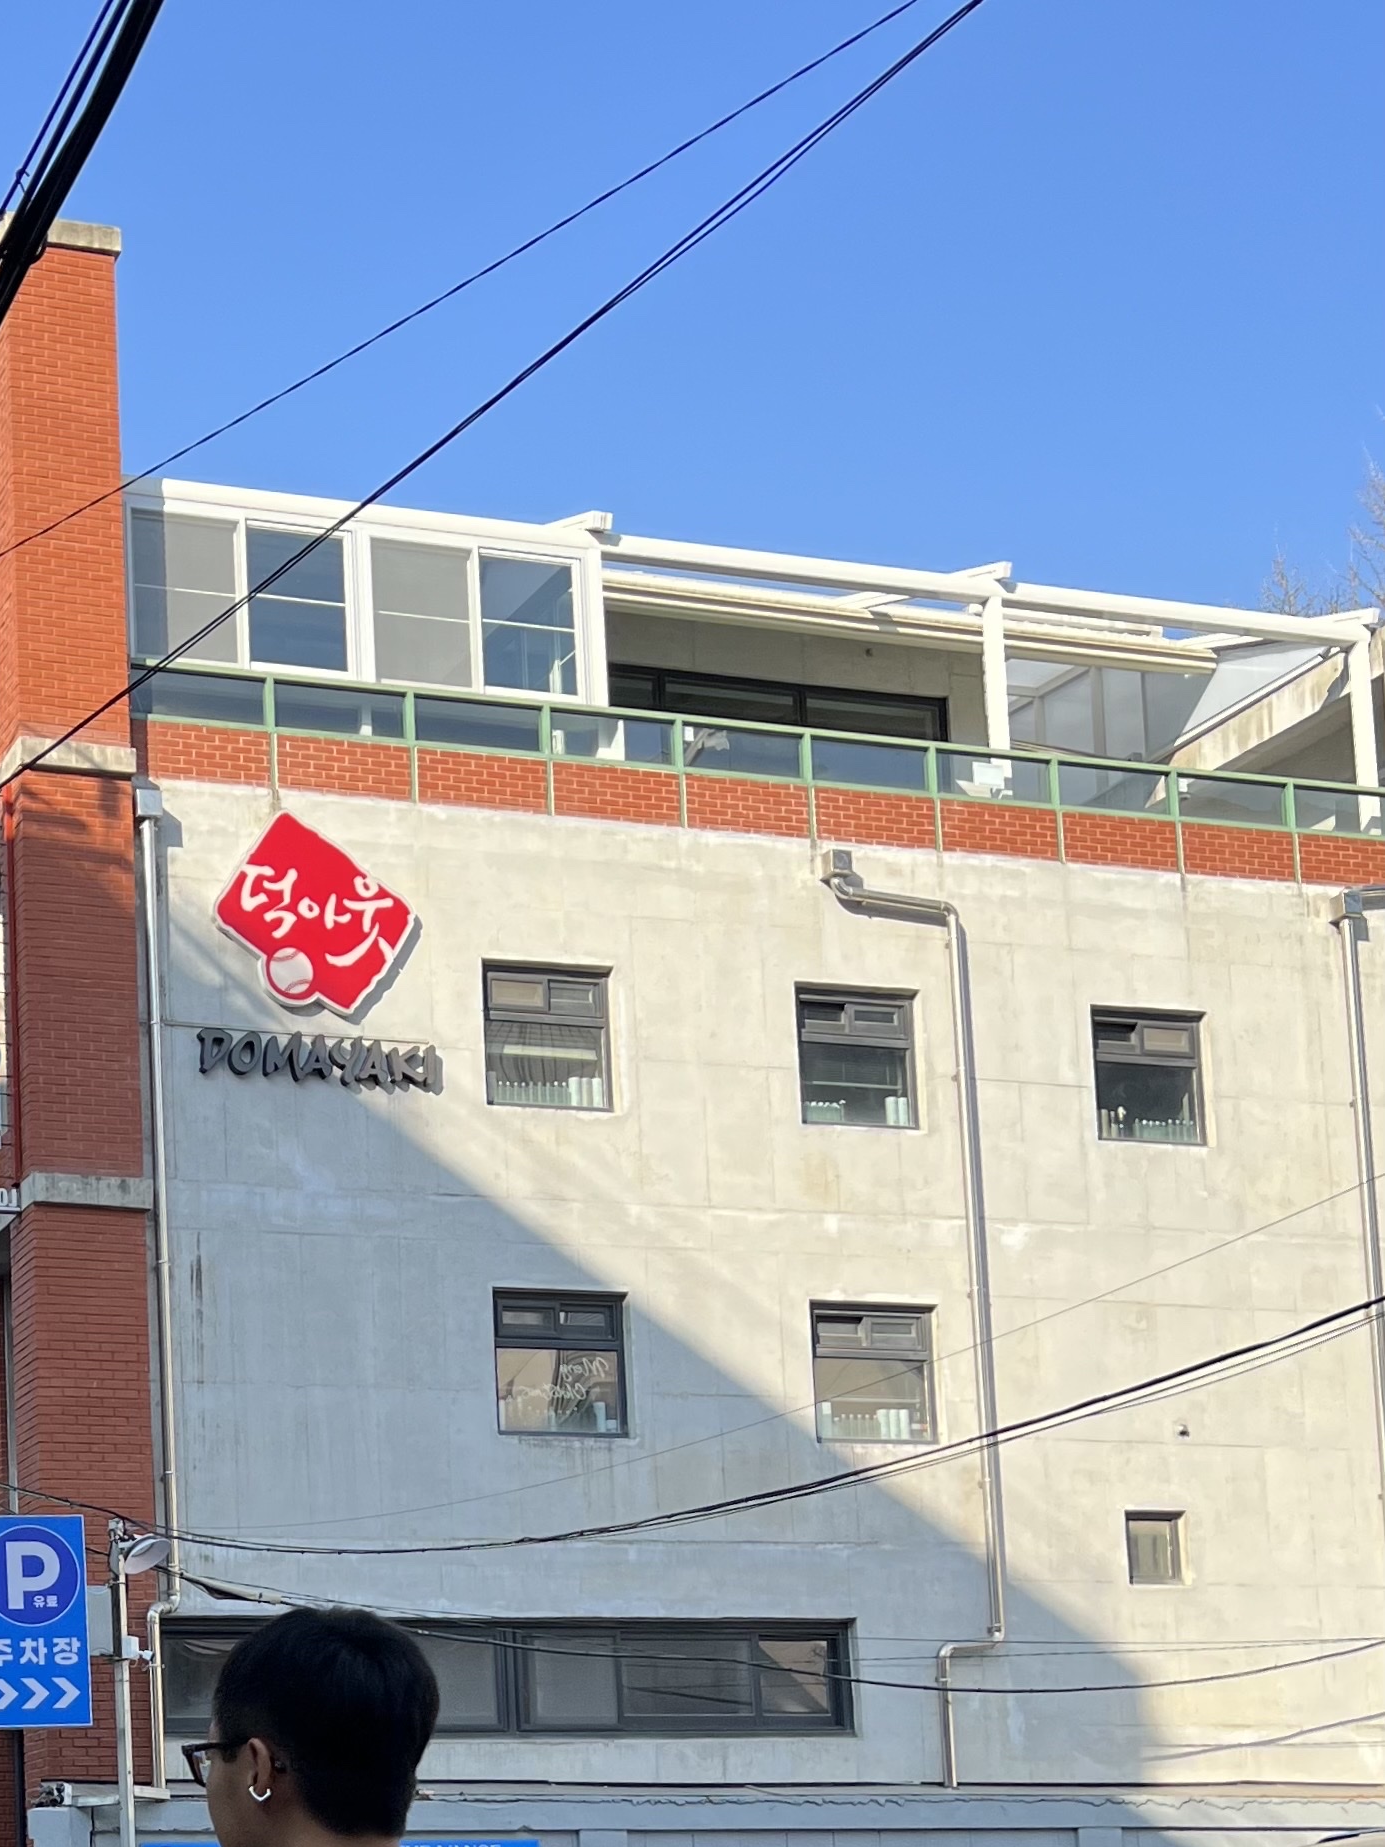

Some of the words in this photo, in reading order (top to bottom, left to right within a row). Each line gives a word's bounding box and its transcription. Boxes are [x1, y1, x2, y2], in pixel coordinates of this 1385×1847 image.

[239, 862, 395, 967] 덕아웃
[197, 1027, 439, 1089] DOMAYAKI
[5, 1541, 60, 1610] P
[33, 1595, 59, 1608] 유료
